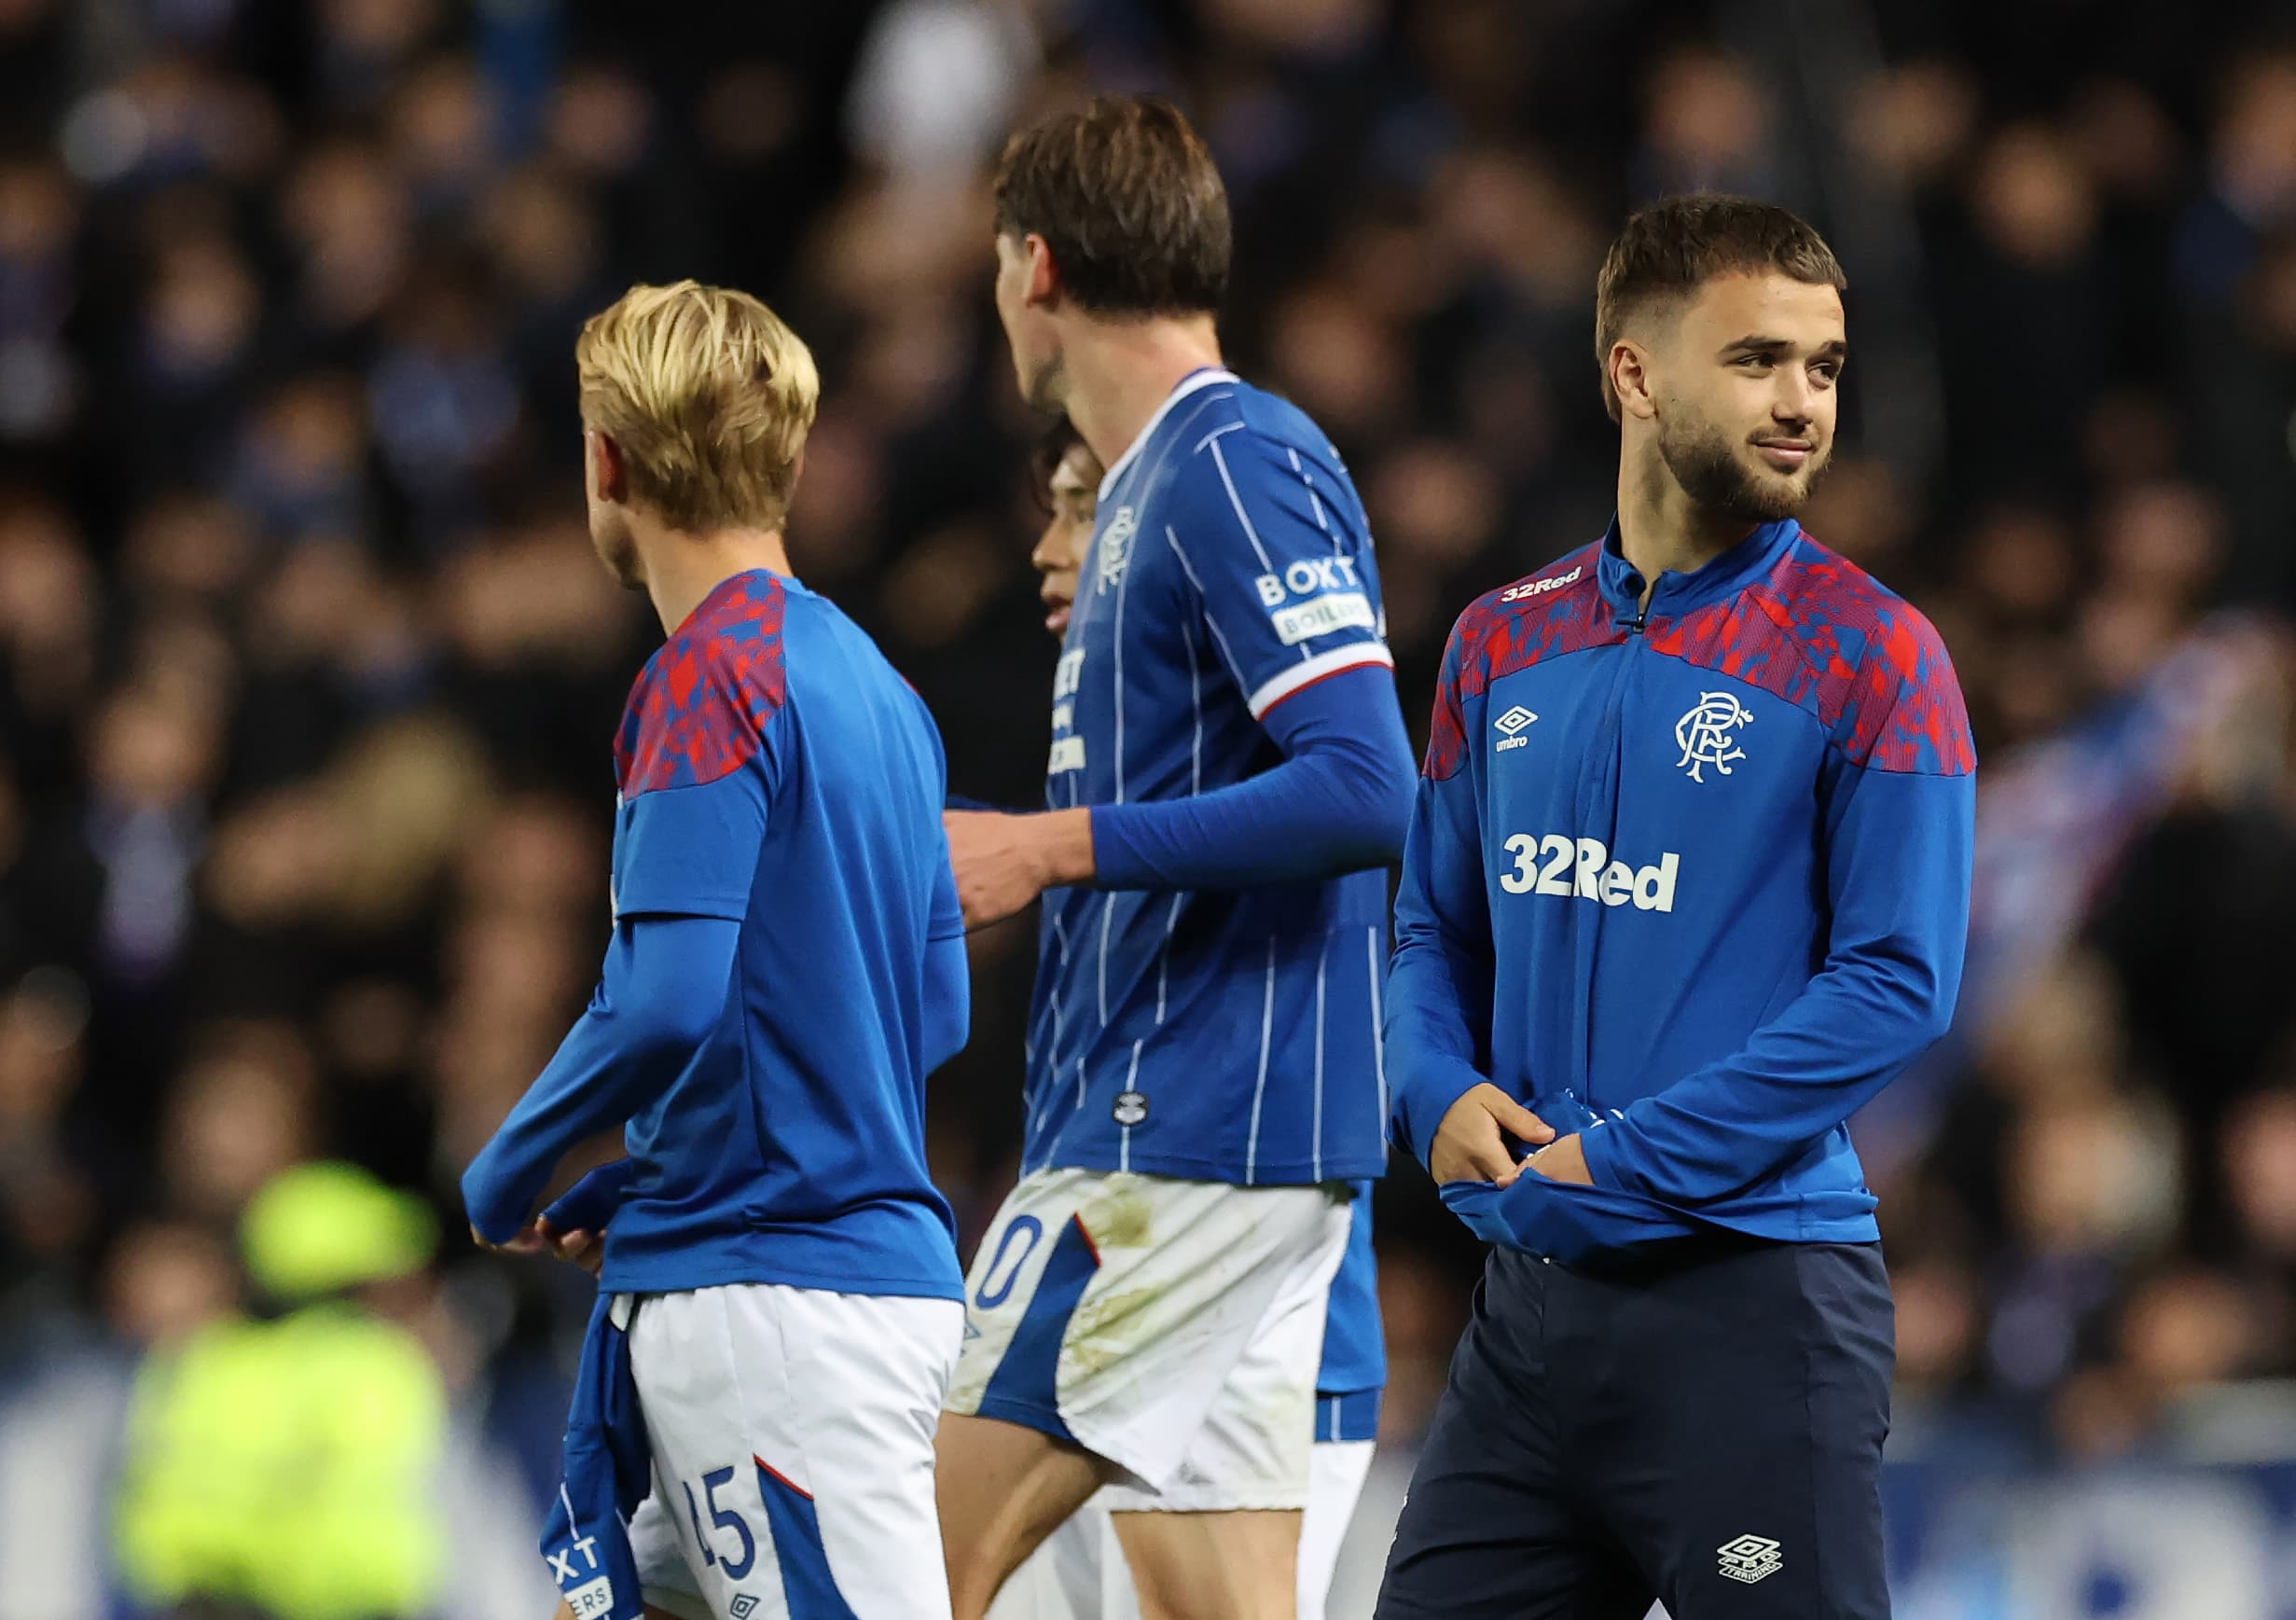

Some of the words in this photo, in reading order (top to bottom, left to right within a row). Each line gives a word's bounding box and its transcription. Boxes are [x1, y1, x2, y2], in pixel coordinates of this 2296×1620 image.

[1254, 556, 1358, 607] BOXT
[1500, 565, 1583, 602] 32Red
[1283, 602, 1365, 634] BOIL
[1496, 735, 1528, 753] umbro
[1500, 833, 1681, 912] 32Red
[975, 1214, 1044, 1310] 0
[1727, 1562, 1777, 1581] TRAINING
